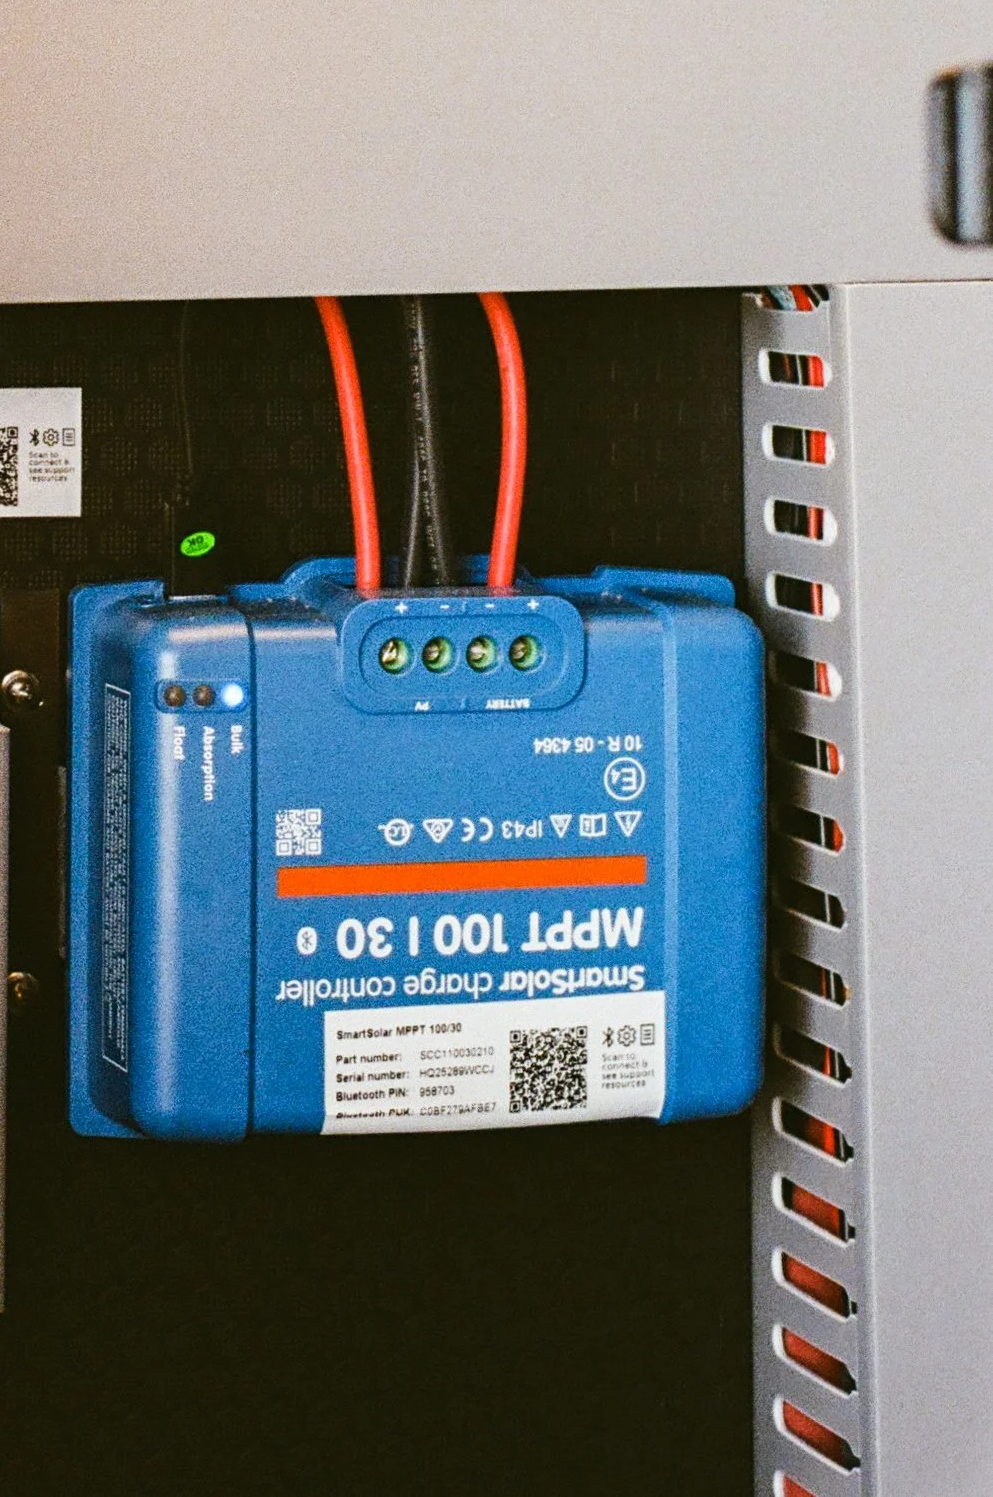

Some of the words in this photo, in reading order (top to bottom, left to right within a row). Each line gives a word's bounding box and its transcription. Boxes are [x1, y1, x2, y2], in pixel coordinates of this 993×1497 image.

[414, 701, 431, 712] PV
[173, 725, 186, 761] Float
[230, 724, 244, 756] Bulk
[532, 737, 572, 755] 4364
[574, 736, 595, 753] 05
[608, 735, 621, 751] R
[623, 734, 643, 751] 10
[201, 725, 216, 801] Absorption
[502, 819, 543, 839] IP43
[335, 916, 394, 960] 30
[433, 912, 509, 955] 100
[520, 906, 644, 953] MPPT
[275, 974, 396, 1007] controller
[403, 967, 493, 1000] charge
[499, 964, 646, 998] SmartSolar
[336, 1028, 392, 1040] SmartSolar
[395, 1025, 426, 1036] MPPT
[430, 1022, 462, 1034] 100/30
[336, 1054, 357, 1065] Part
[360, 1052, 402, 1064] number:
[336, 1072, 365, 1084] Serial
[368, 1071, 409, 1082] number:
[336, 1089, 386, 1102] Bluetooth
[388, 1087, 410, 1098] PIN:
